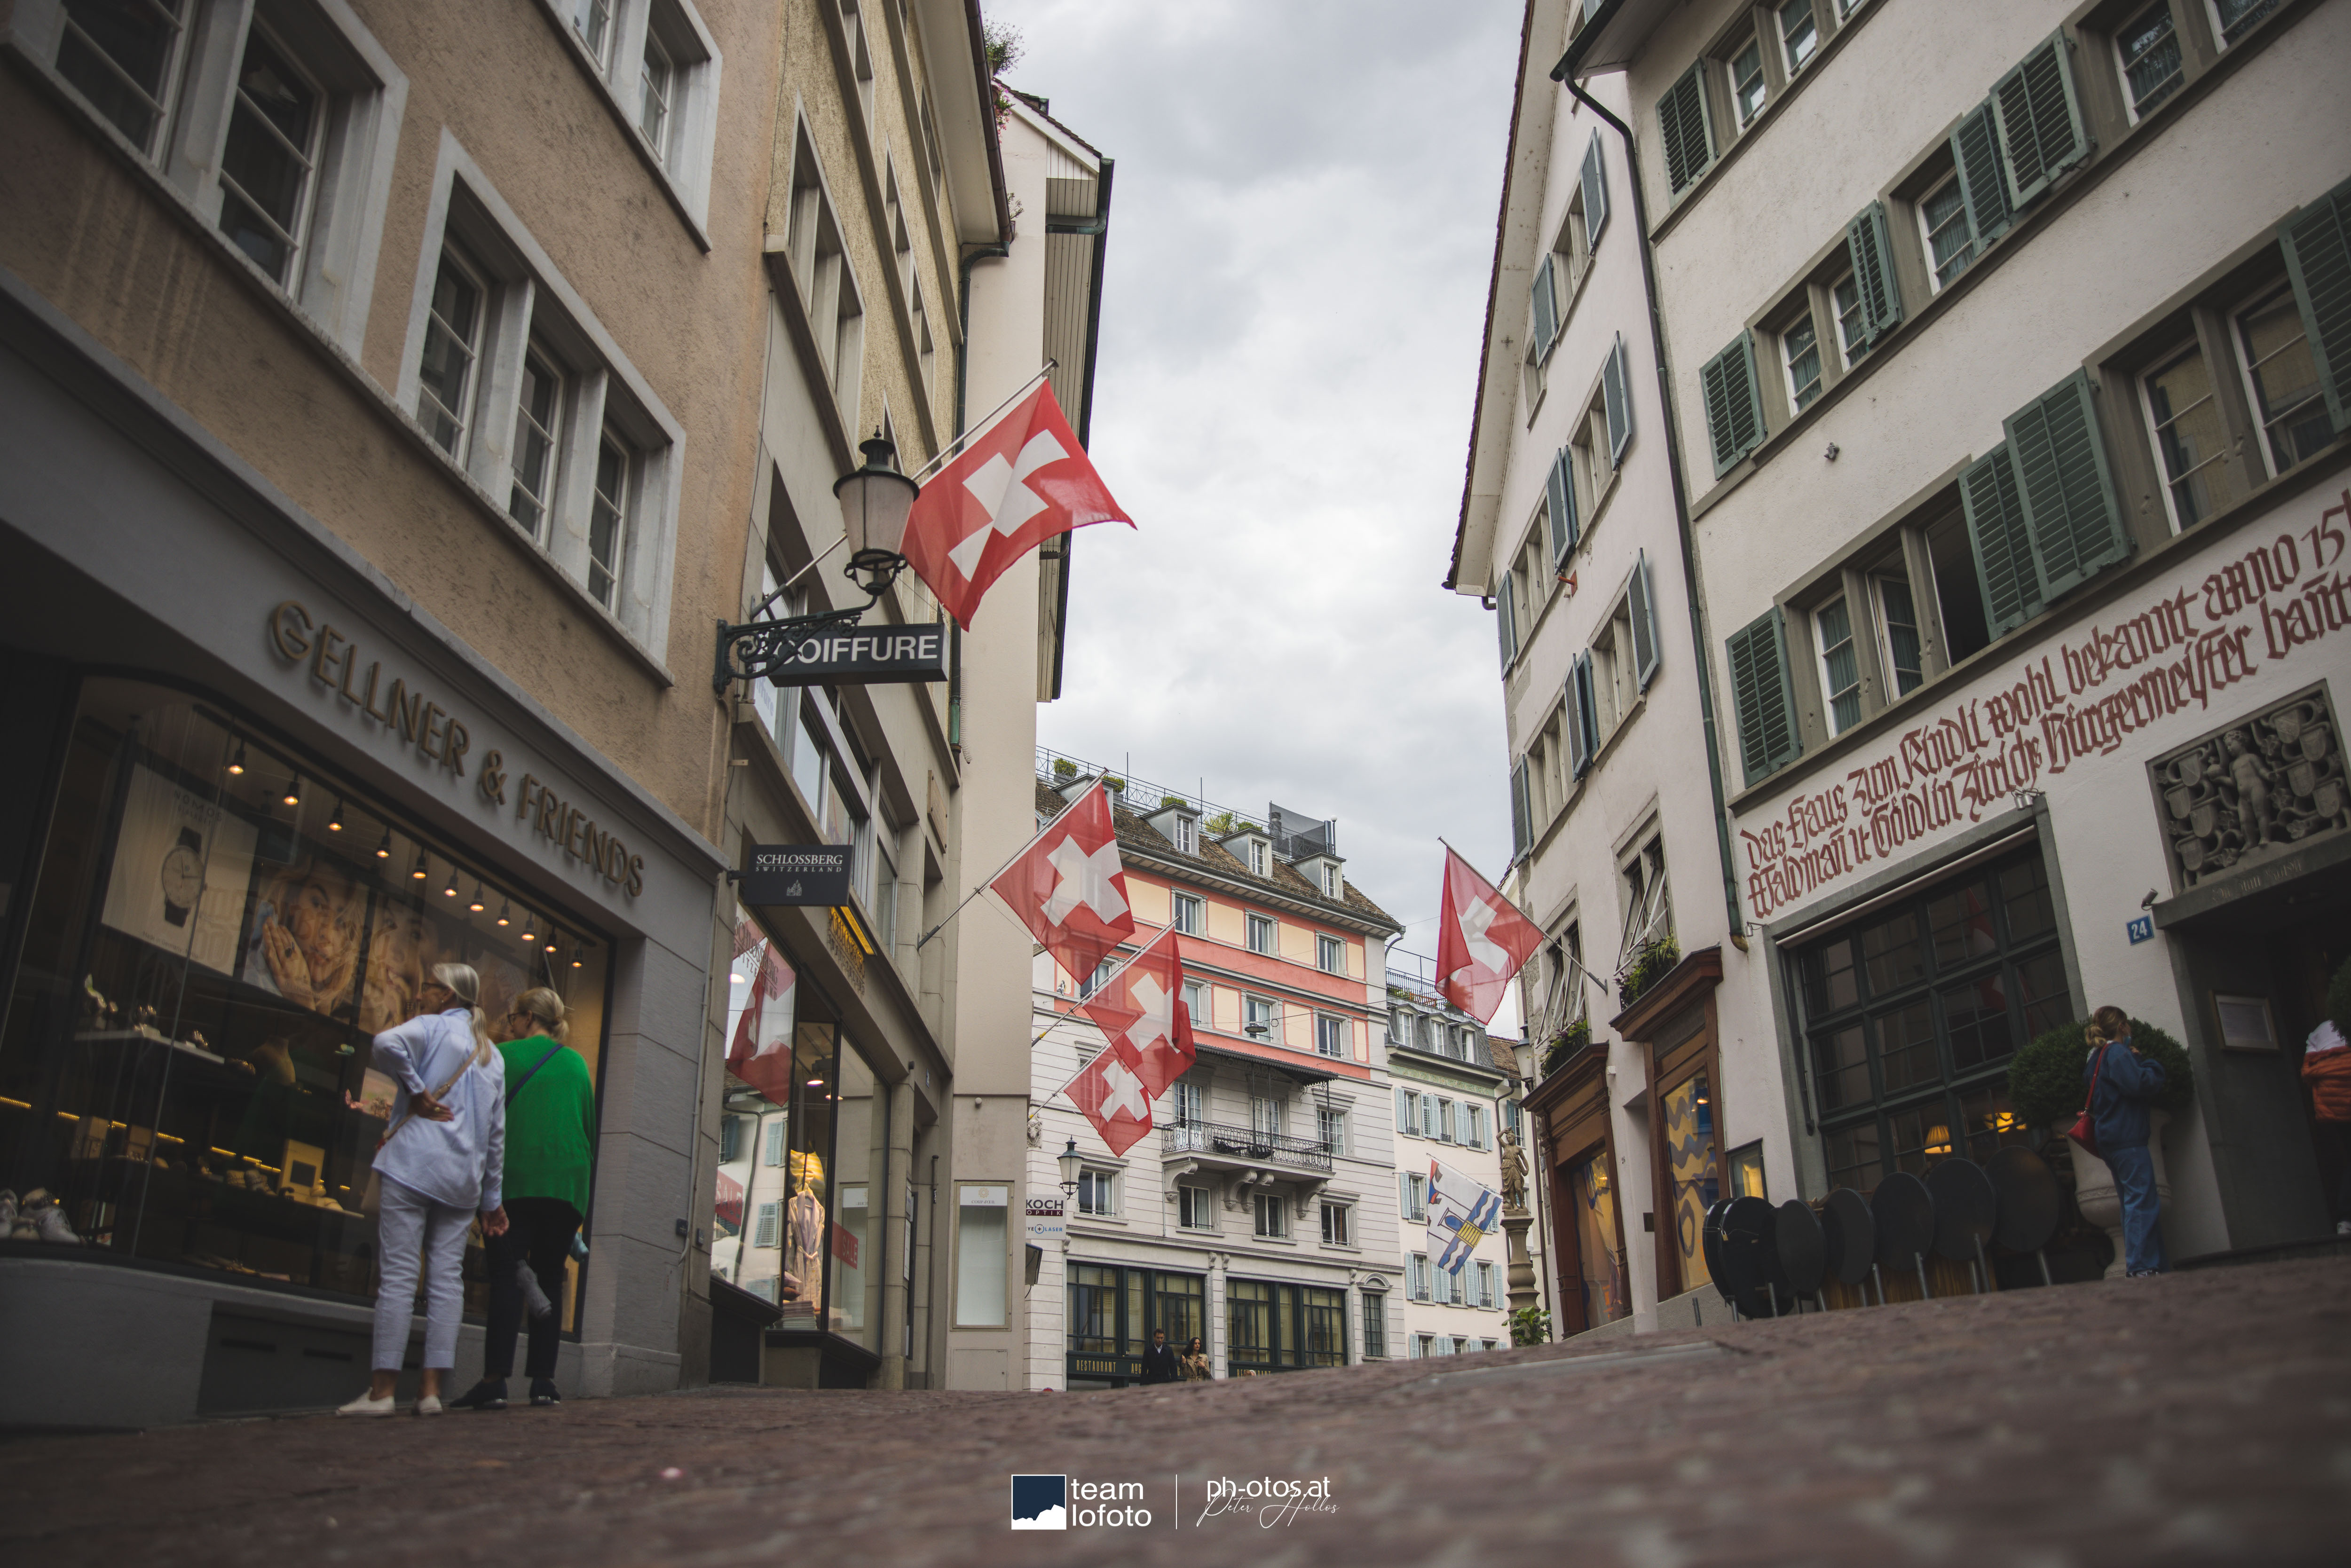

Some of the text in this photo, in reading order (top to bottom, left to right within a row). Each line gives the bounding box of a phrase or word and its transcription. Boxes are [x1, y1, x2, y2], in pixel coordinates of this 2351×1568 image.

[1740, 820, 1786, 870] Das
[1786, 784, 1848, 853] Haus
[1899, 698, 1990, 790] Kindli
[2061, 585, 2200, 695] bekannt
[2201, 534, 2300, 621] anno
[2038, 625, 2258, 773] Bürgermeister
[273, 600, 644, 897] GELLNER & FRIENDS
[174, 789, 222, 822] NOMOS
[756, 854, 843, 865] SCHLOSSBERG
[2131, 921, 2147, 939] 24
[734, 917, 779, 985] SCHLOSSBERG
[733, 943, 777, 1001] SWITZERLAND
[715, 1179, 742, 1219] SALE
[1026, 1199, 1063, 1209] KOCH
[843, 1236, 857, 1264] SALE
[1076, 1360, 1116, 1373] RESTAURANT
